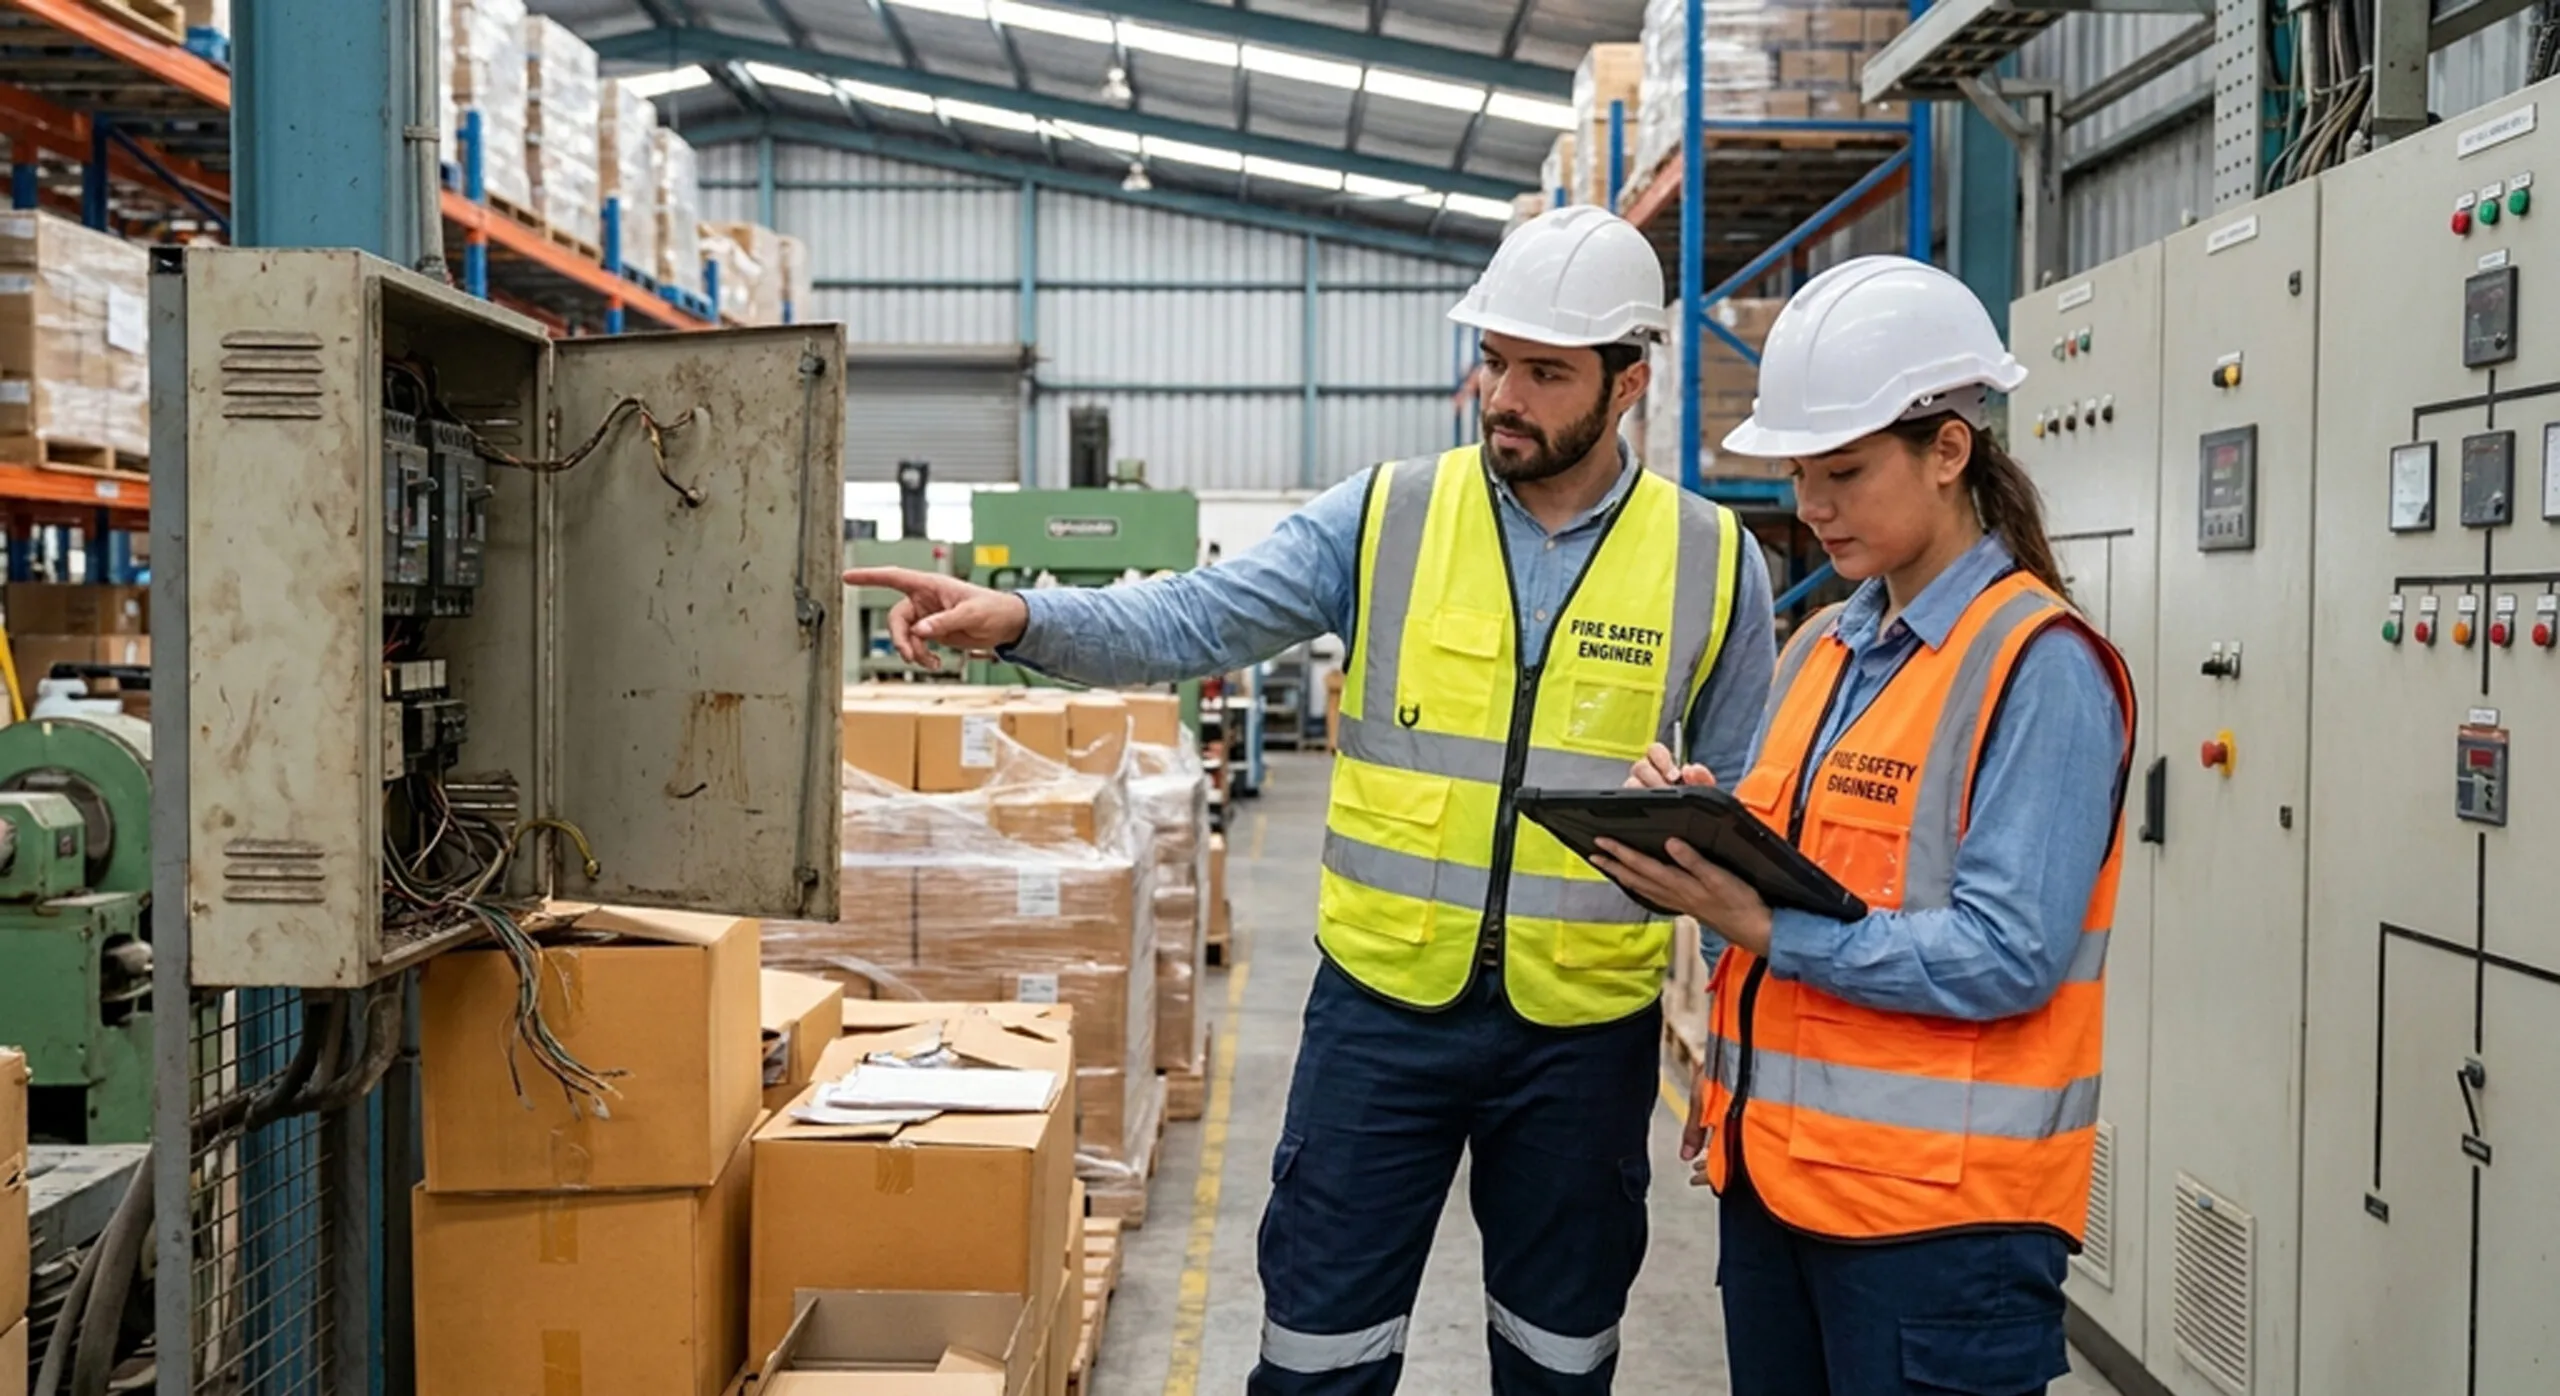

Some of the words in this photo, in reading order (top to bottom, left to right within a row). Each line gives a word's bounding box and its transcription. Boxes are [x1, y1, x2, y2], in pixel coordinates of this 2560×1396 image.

[1571, 620, 1604, 638] FIRE
[1609, 624, 1663, 646] SAFETY
[1578, 641, 1653, 666] ENGINEER
